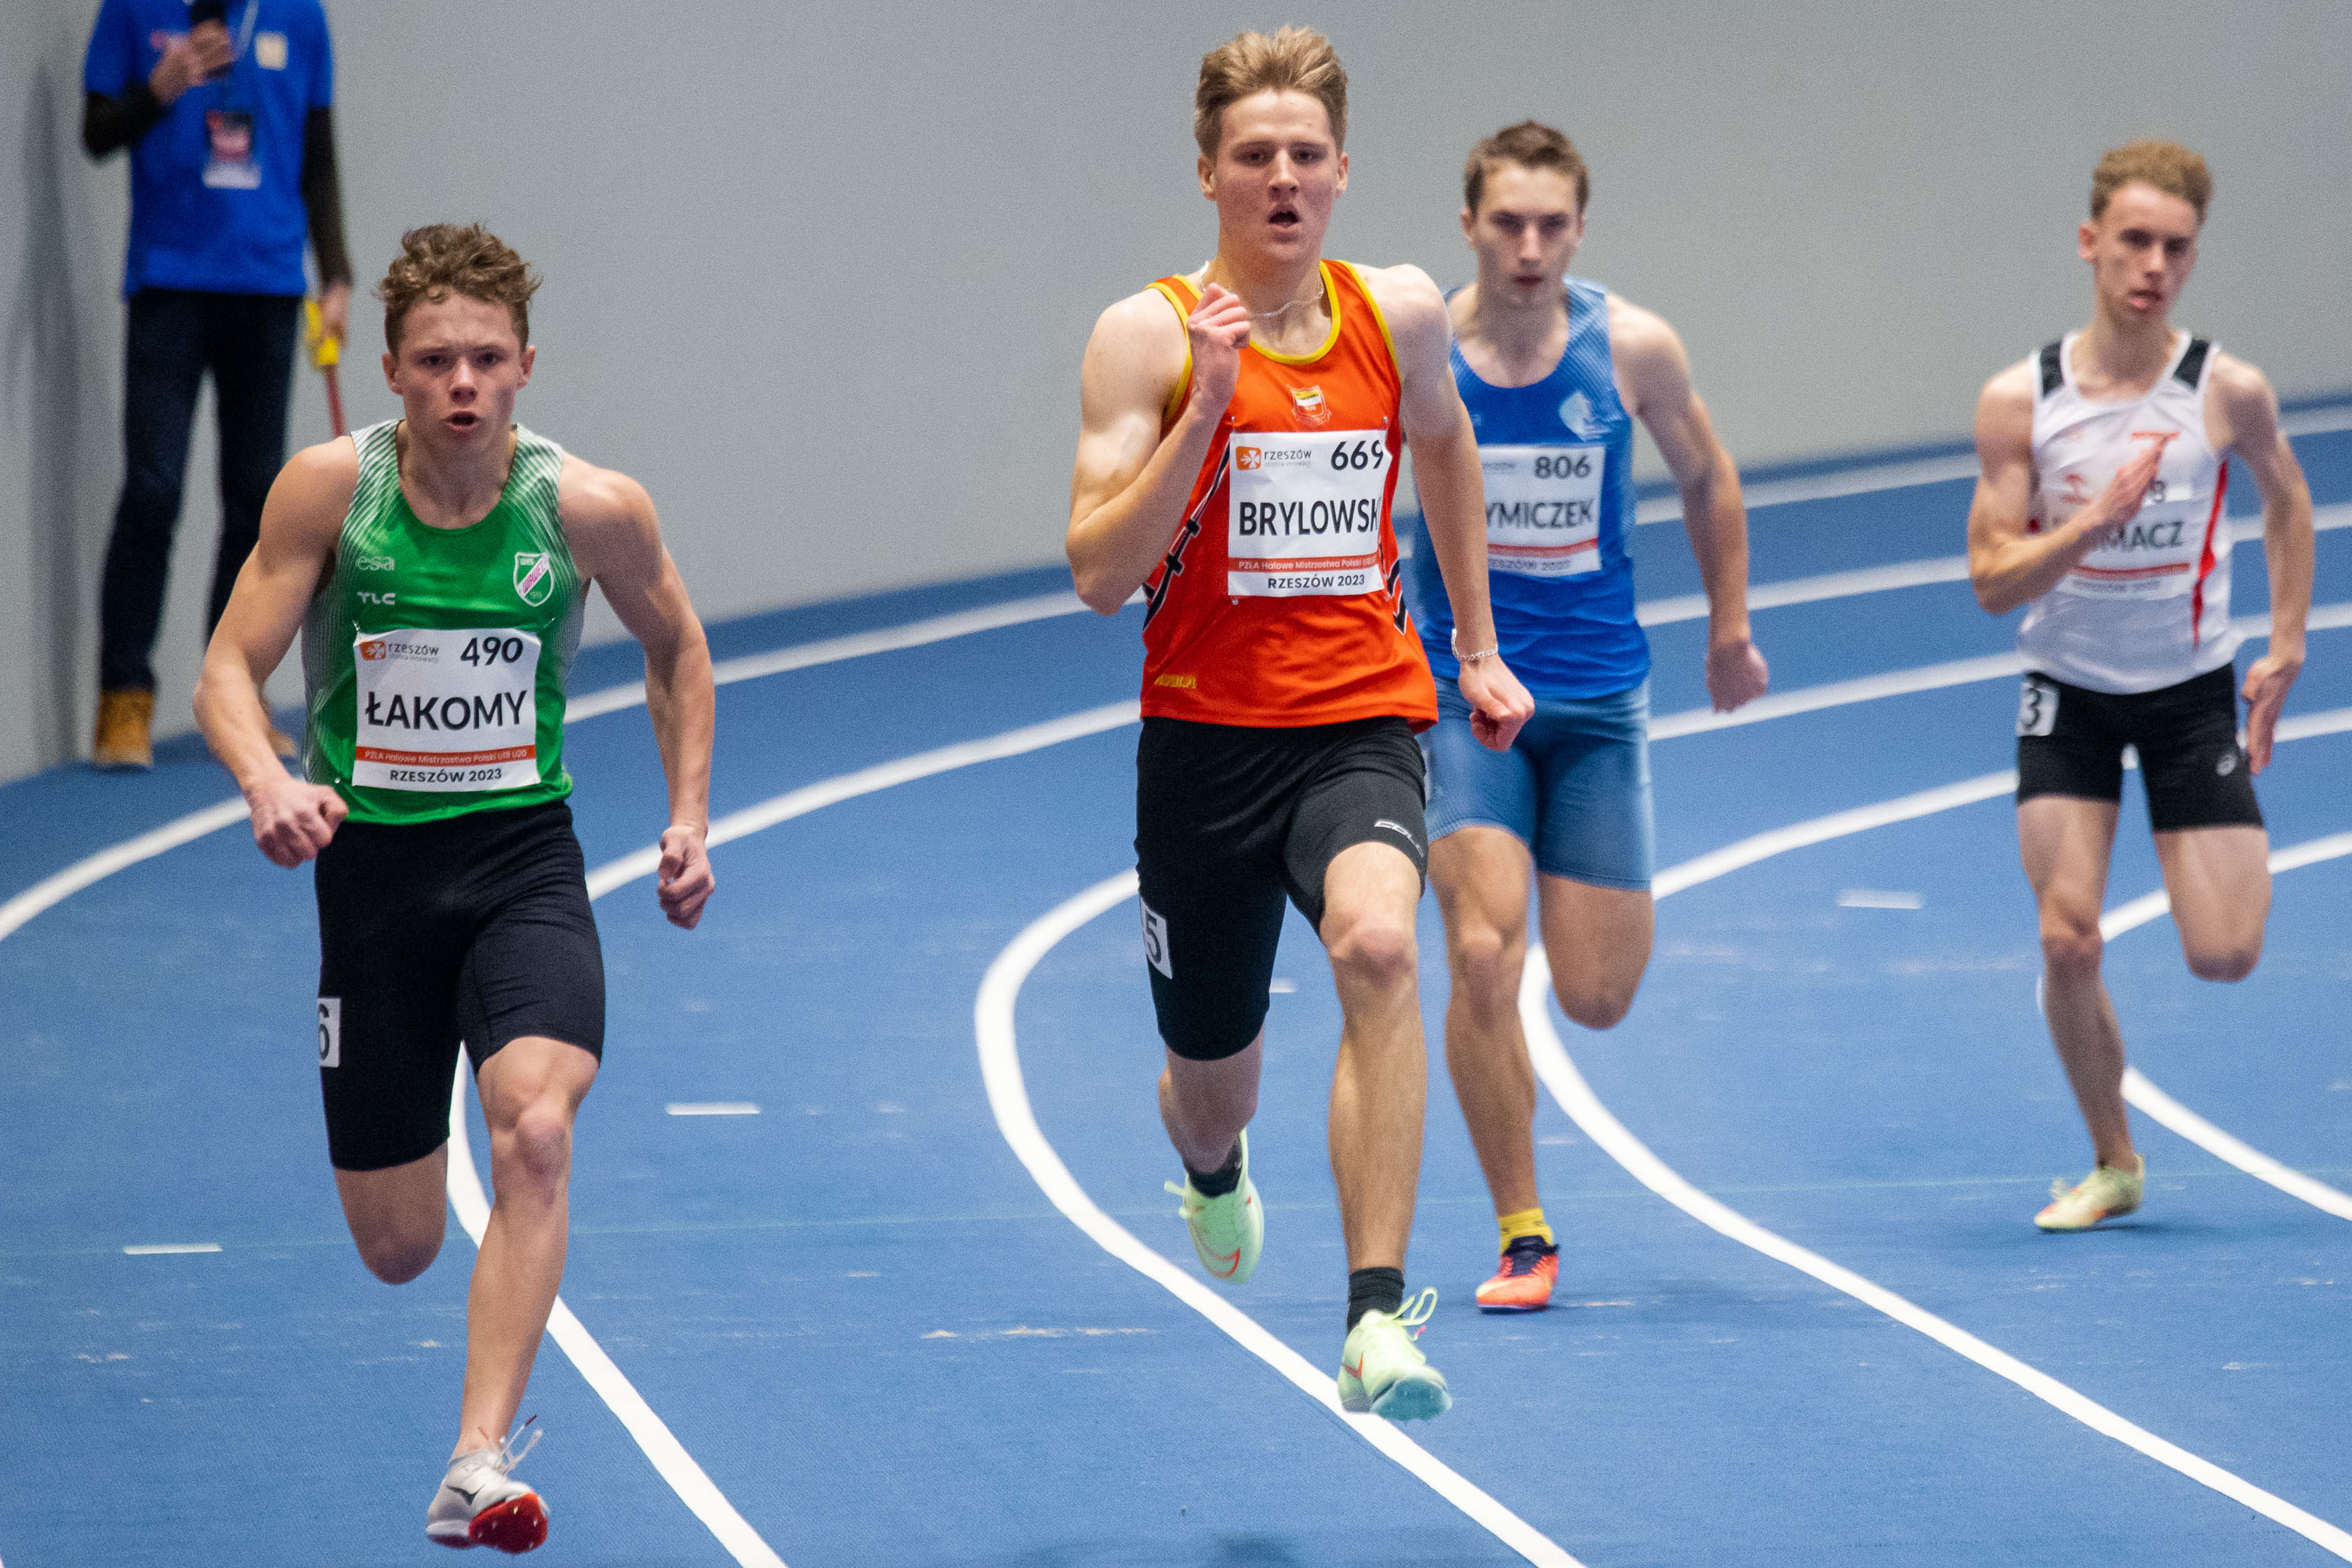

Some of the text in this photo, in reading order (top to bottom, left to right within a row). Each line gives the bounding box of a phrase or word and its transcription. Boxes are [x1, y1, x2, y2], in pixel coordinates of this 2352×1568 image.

[1264, 448, 1312, 461] rzeszów
[1330, 439, 1384, 470] 669
[1534, 455, 1592, 480] 806
[1261, 561, 1294, 571] Halowe
[1295, 559, 1341, 570] Mistrzostwa
[1341, 558, 1362, 568] Polski
[1267, 573, 1366, 590] RZESZÓW 2023
[357, 591, 396, 605] TLC
[388, 643, 439, 655] rzeszów
[460, 636, 524, 666] 490
[365, 690, 528, 731] ŁAKOMY
[2023, 686, 2043, 731] 3
[385, 753, 417, 763] Halowe
[418, 756, 472, 765] Mistrzostwa
[473, 752, 496, 763] Polski
[390, 768, 503, 783] RZESZÓW 2023
[1145, 909, 1162, 964] 5
